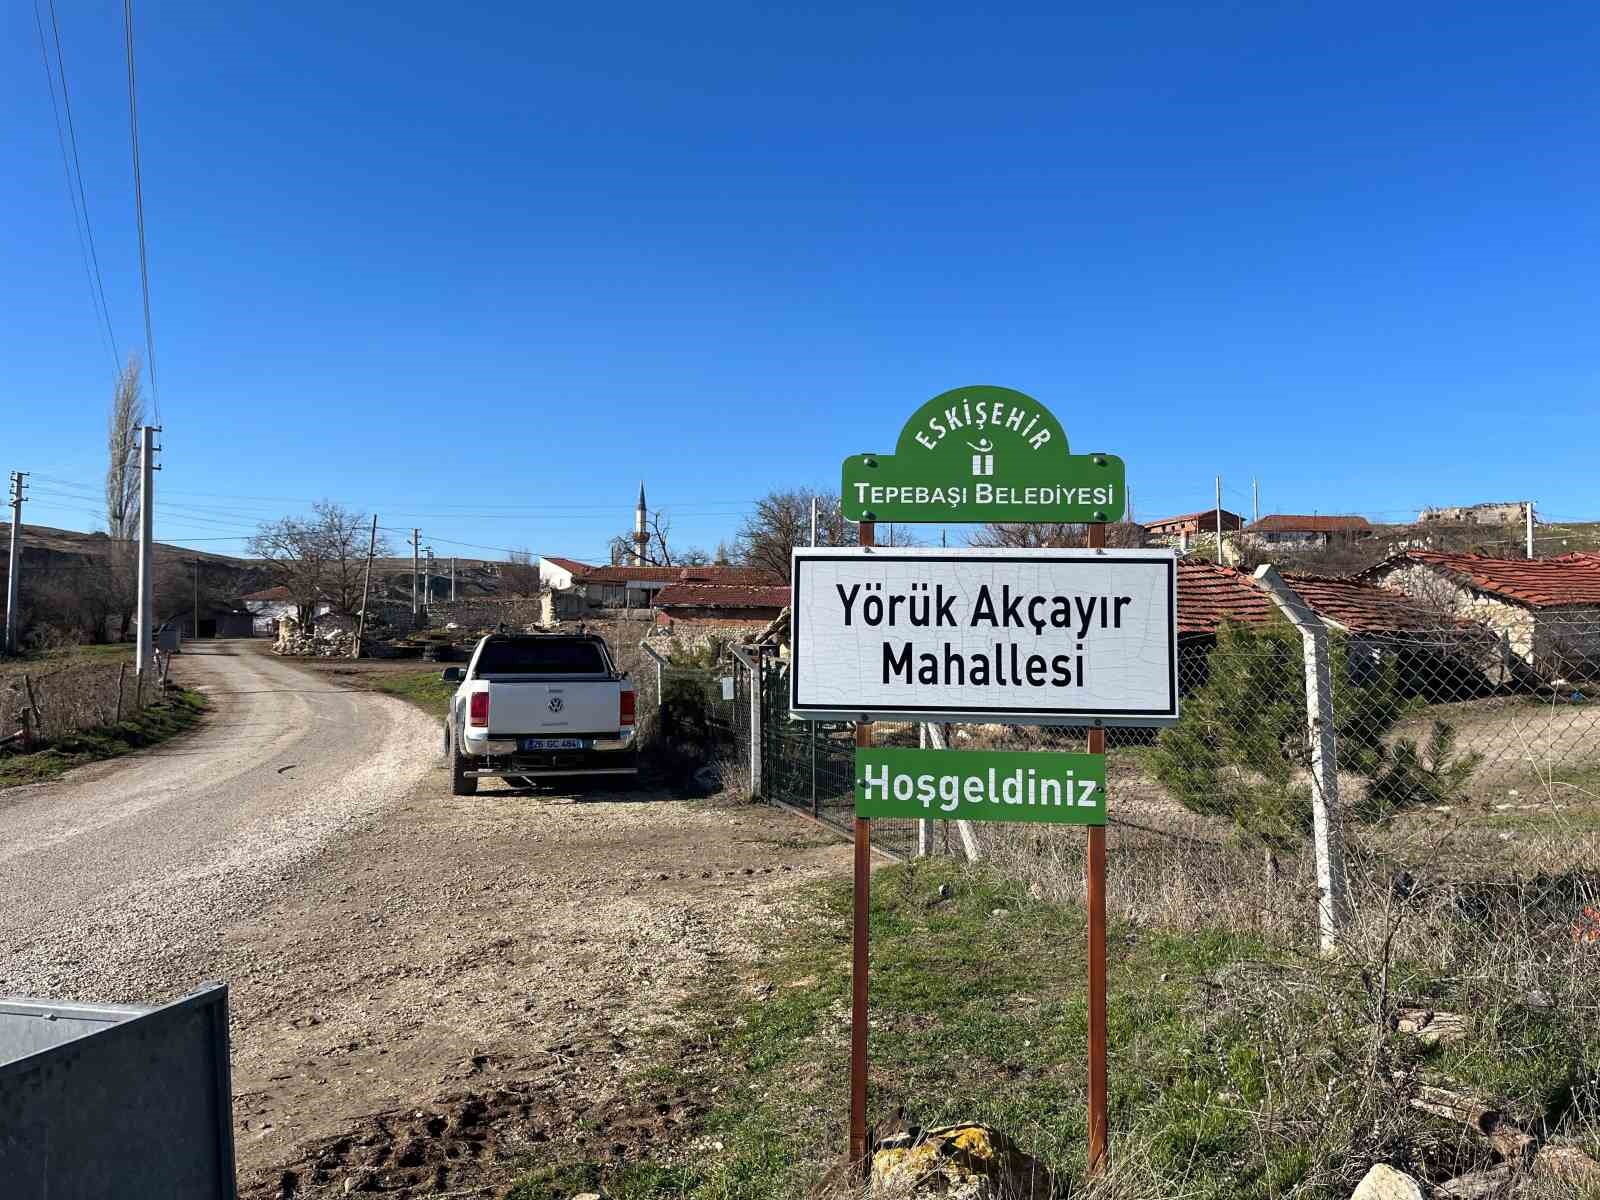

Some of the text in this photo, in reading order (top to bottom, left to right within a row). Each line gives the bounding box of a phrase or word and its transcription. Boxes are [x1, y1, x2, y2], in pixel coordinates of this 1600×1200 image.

[915, 398, 1051, 450] ESKİŞEHİR
[835, 582, 1132, 640] Yörük Akçayır
[882, 641, 1084, 688] Mahallesi
[864, 764, 1098, 812] Hoşgeldiniz
